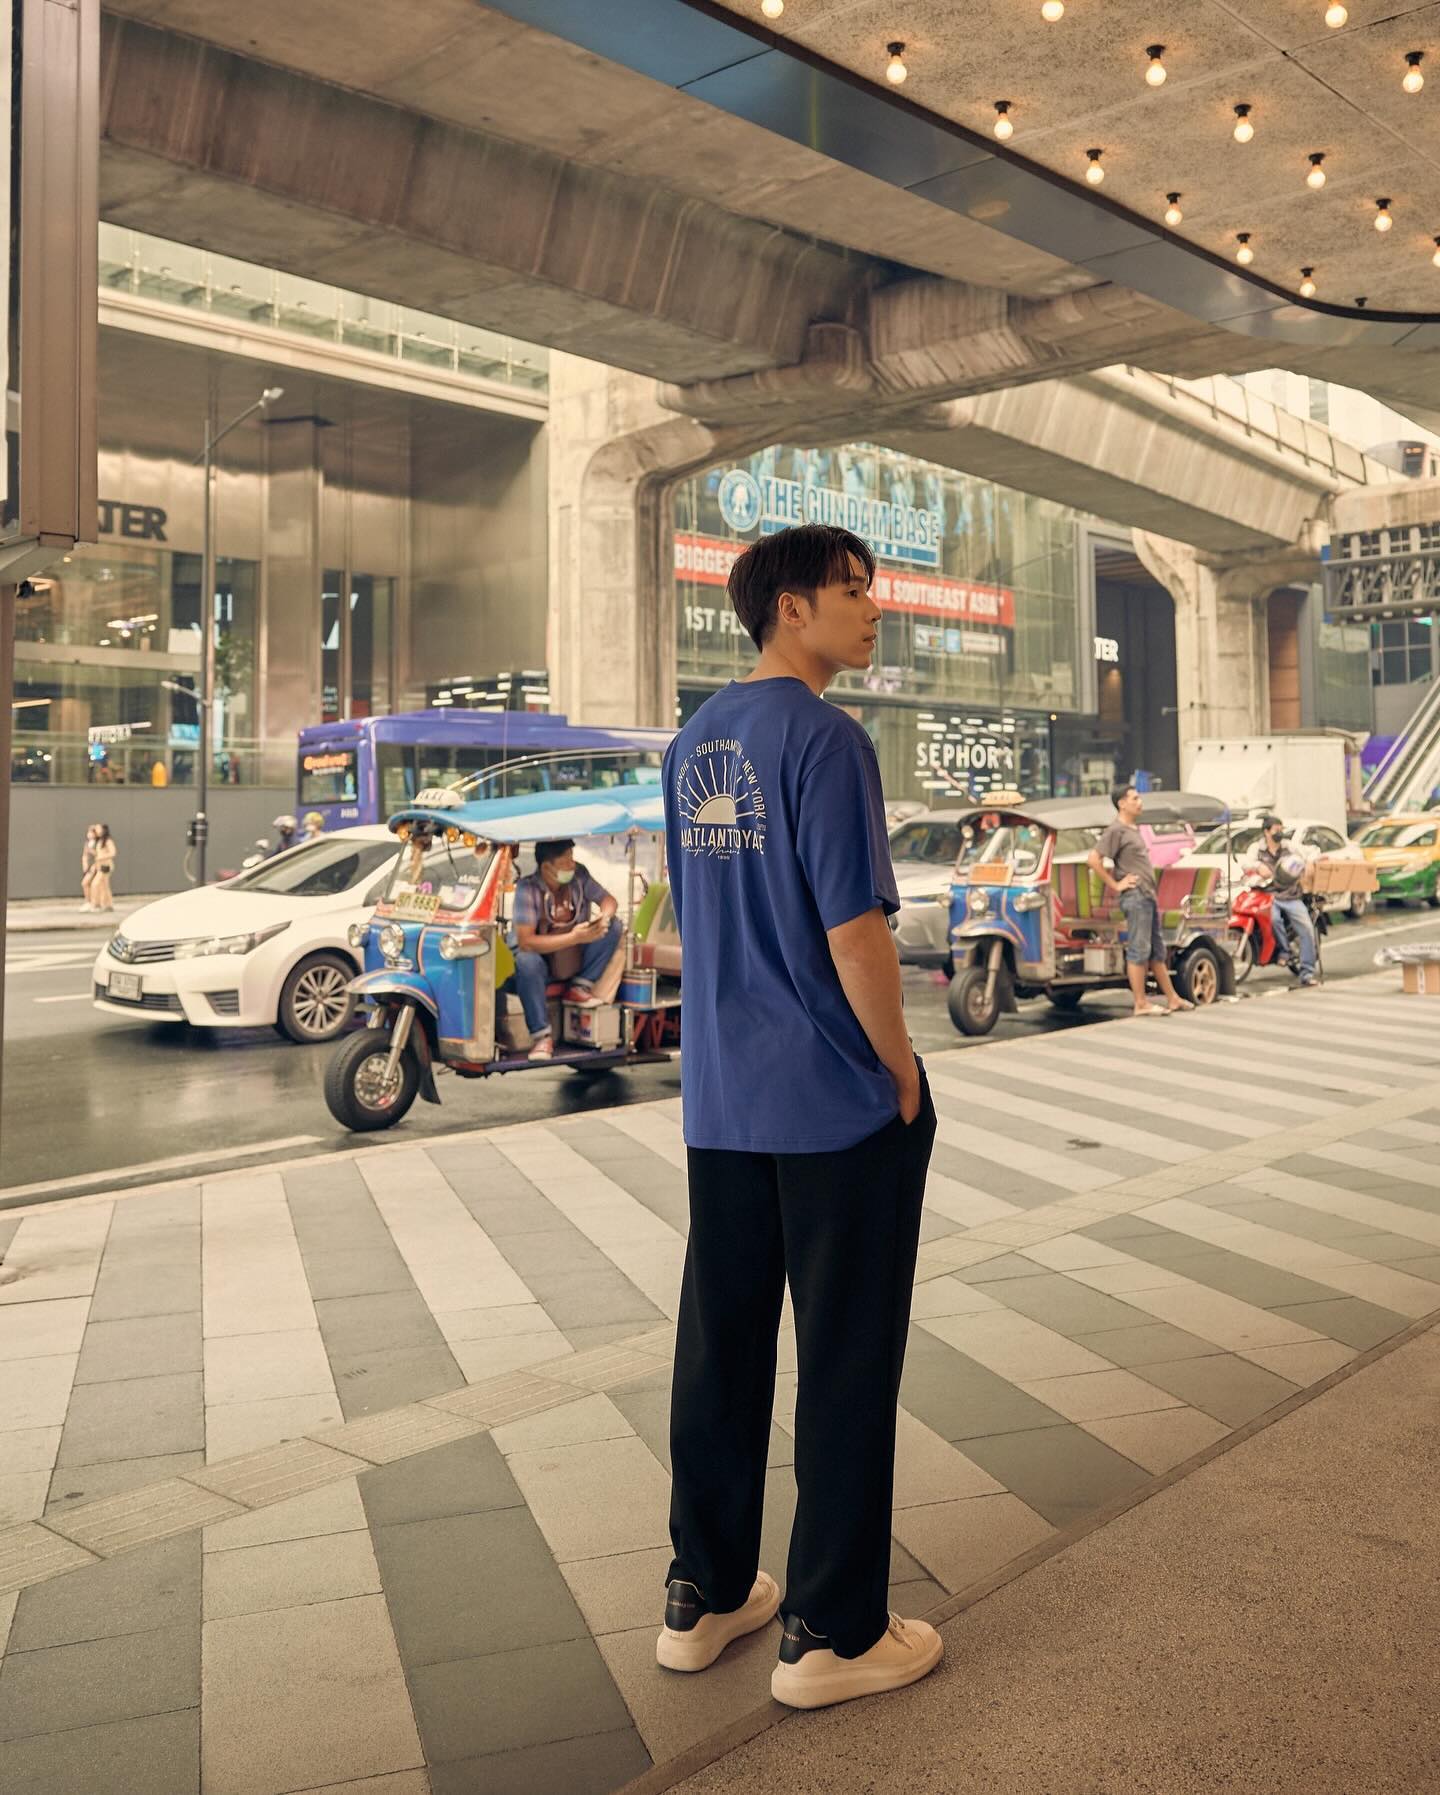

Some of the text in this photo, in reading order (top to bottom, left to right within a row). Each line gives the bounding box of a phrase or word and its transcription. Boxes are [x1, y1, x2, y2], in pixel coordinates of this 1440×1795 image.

[765, 478, 801, 519] THE
[803, 487, 890, 538] GUNDAM
[891, 504, 939, 546] BASE
[875, 575, 891, 600] IN
[893, 579, 967, 610] SOUTHEAST
[685, 606, 716, 632] 1ST
[916, 742, 1013, 769] SEPHORA
[742, 760, 757, 784] NEW
[752, 787, 767, 819] YORK
